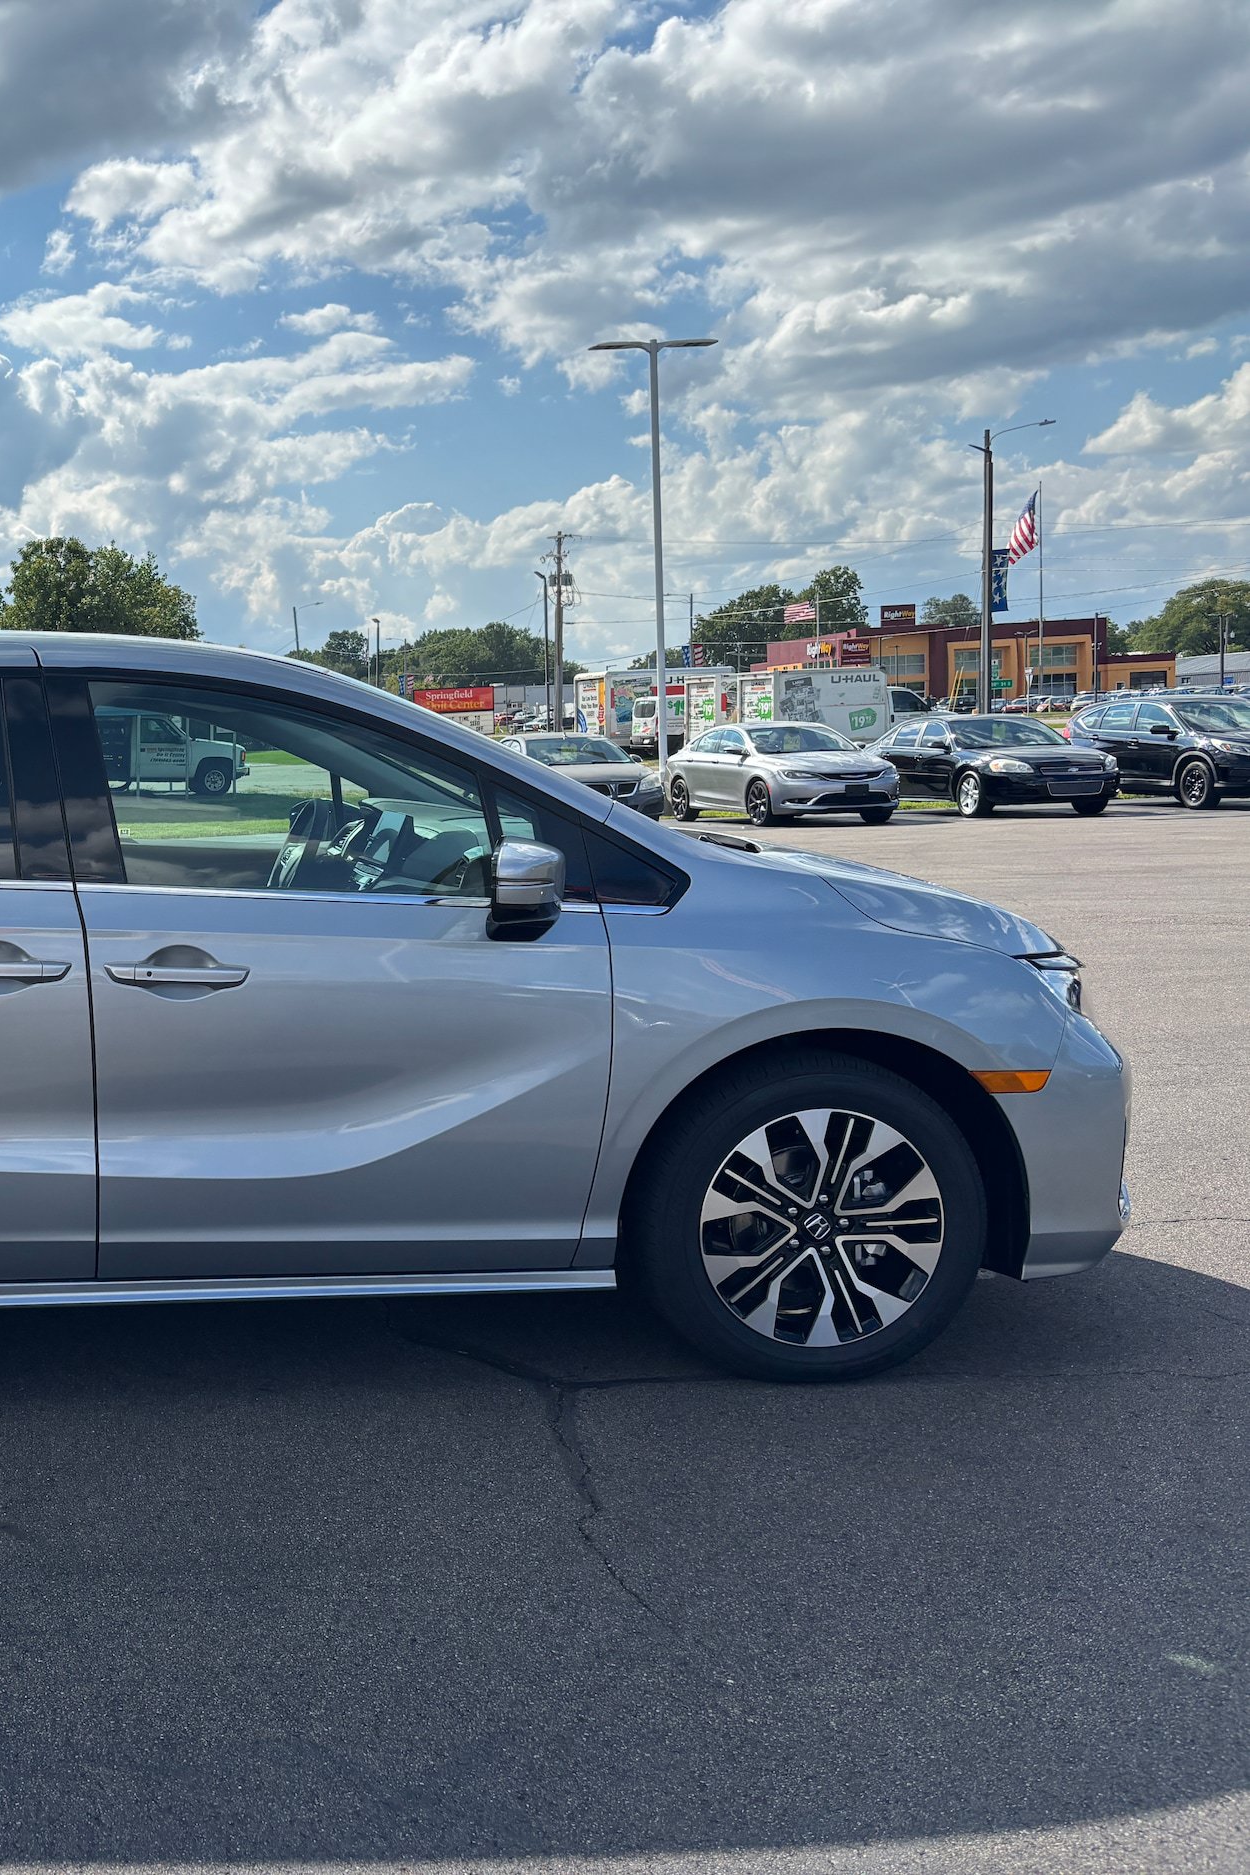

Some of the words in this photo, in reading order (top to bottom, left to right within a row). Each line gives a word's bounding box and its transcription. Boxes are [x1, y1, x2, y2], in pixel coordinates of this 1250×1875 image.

[883, 610, 915, 620] RightWay
[842, 642, 870, 651] RightWay
[831, 674, 880, 684] U-HAUL
[425, 689, 473, 701] Springfield
[450, 700, 485, 710] Center
